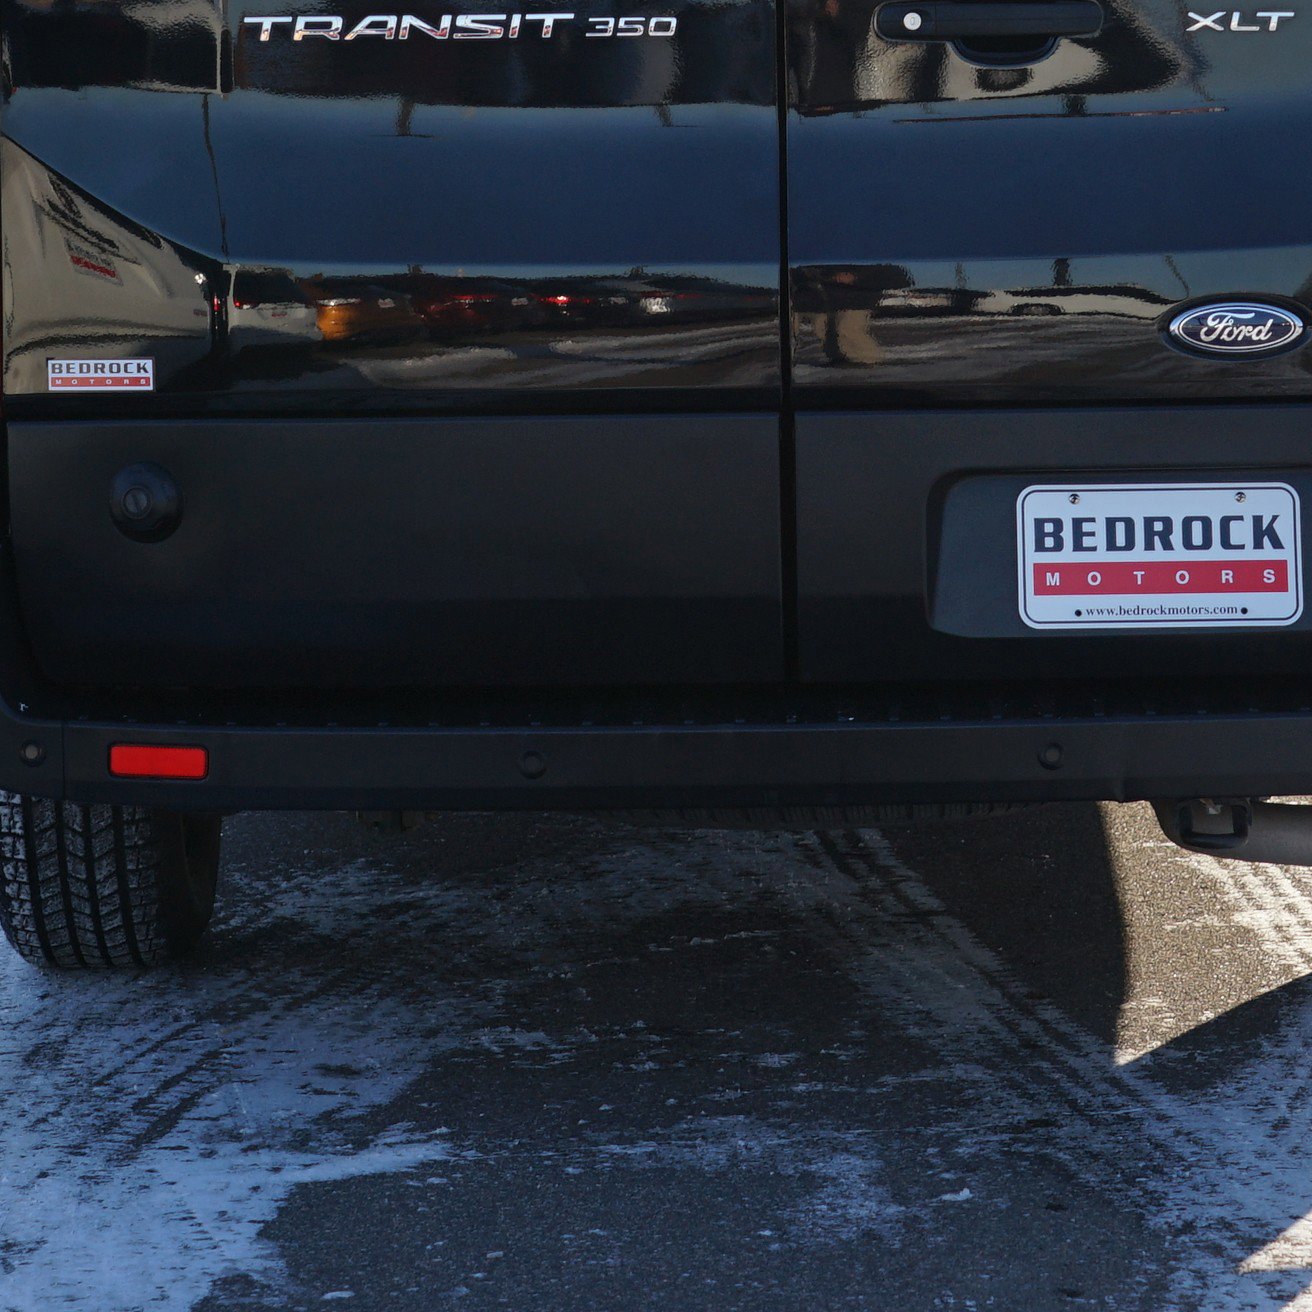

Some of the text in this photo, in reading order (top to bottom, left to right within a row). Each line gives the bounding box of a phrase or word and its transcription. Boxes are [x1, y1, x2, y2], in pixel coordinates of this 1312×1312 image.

[243, 13, 677, 42] TRANSIT 350
[1186, 11, 1295, 31] XLT
[1199, 312, 1274, 342] Ford
[51, 362, 149, 374] BEDROCK
[1033, 514, 1285, 553] BEDROCK
[1046, 569, 1276, 586] MOTORS
[1086, 604, 1238, 617] www.bedrockmotors.com
